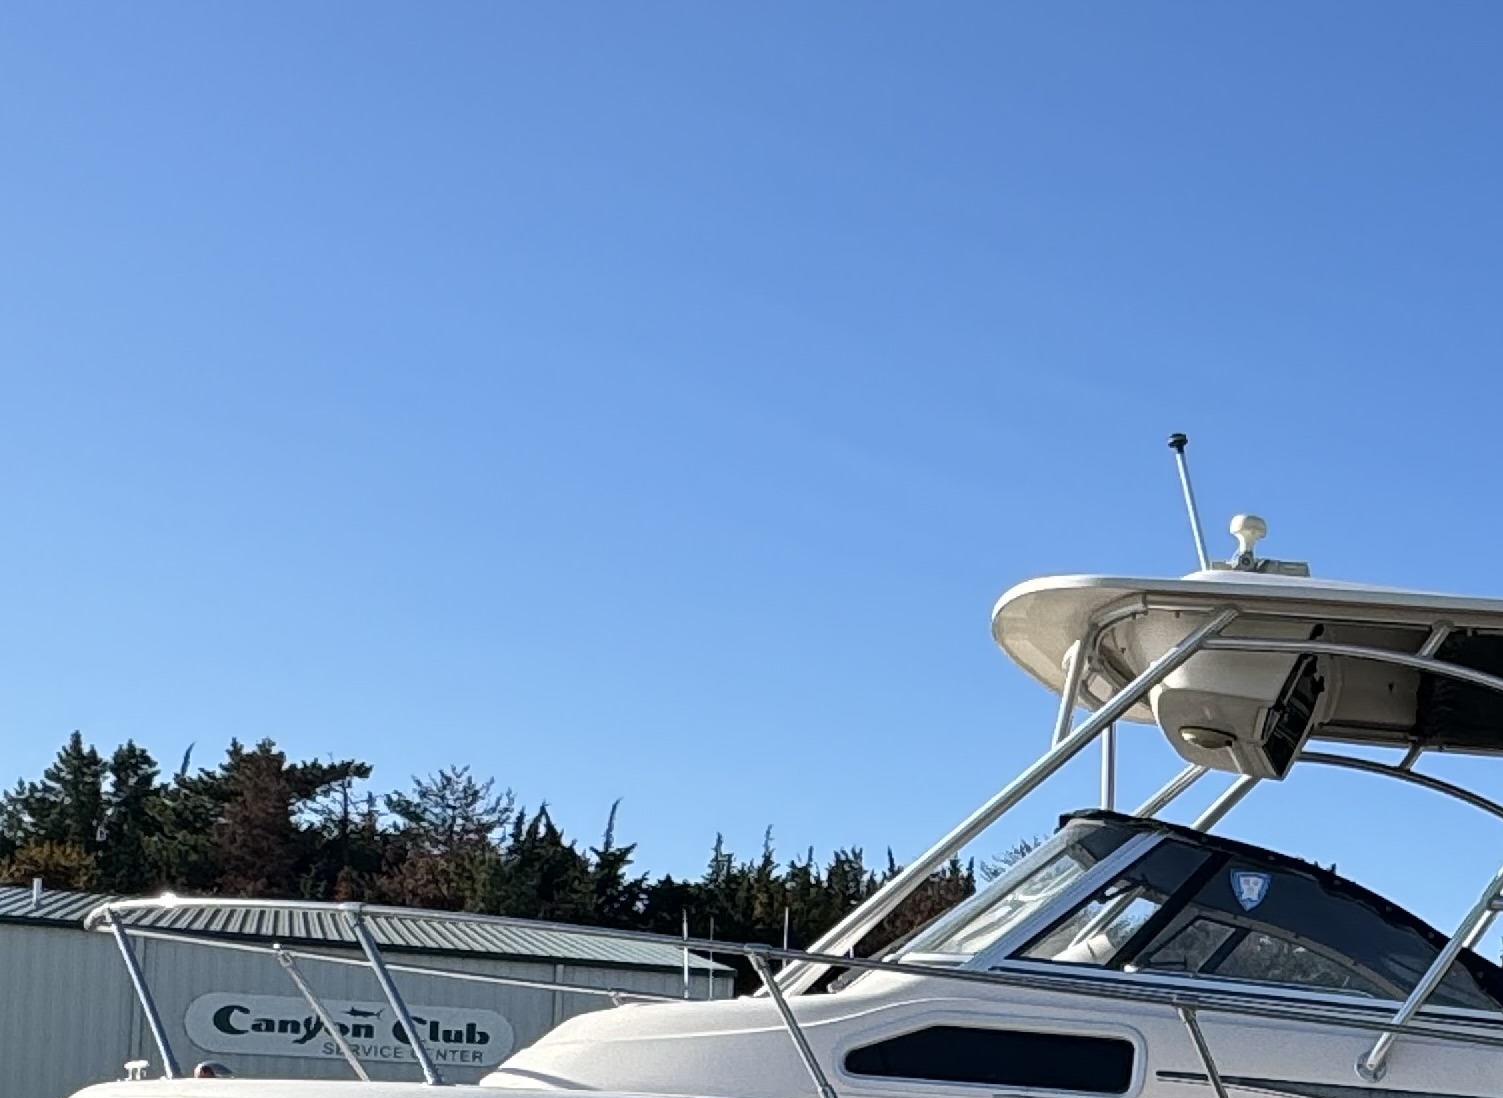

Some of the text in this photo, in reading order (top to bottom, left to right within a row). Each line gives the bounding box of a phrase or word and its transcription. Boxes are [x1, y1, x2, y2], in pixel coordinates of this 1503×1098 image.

[212, 1005, 490, 1045] Canyon Club
[322, 1041, 404, 1059] SERVICE
